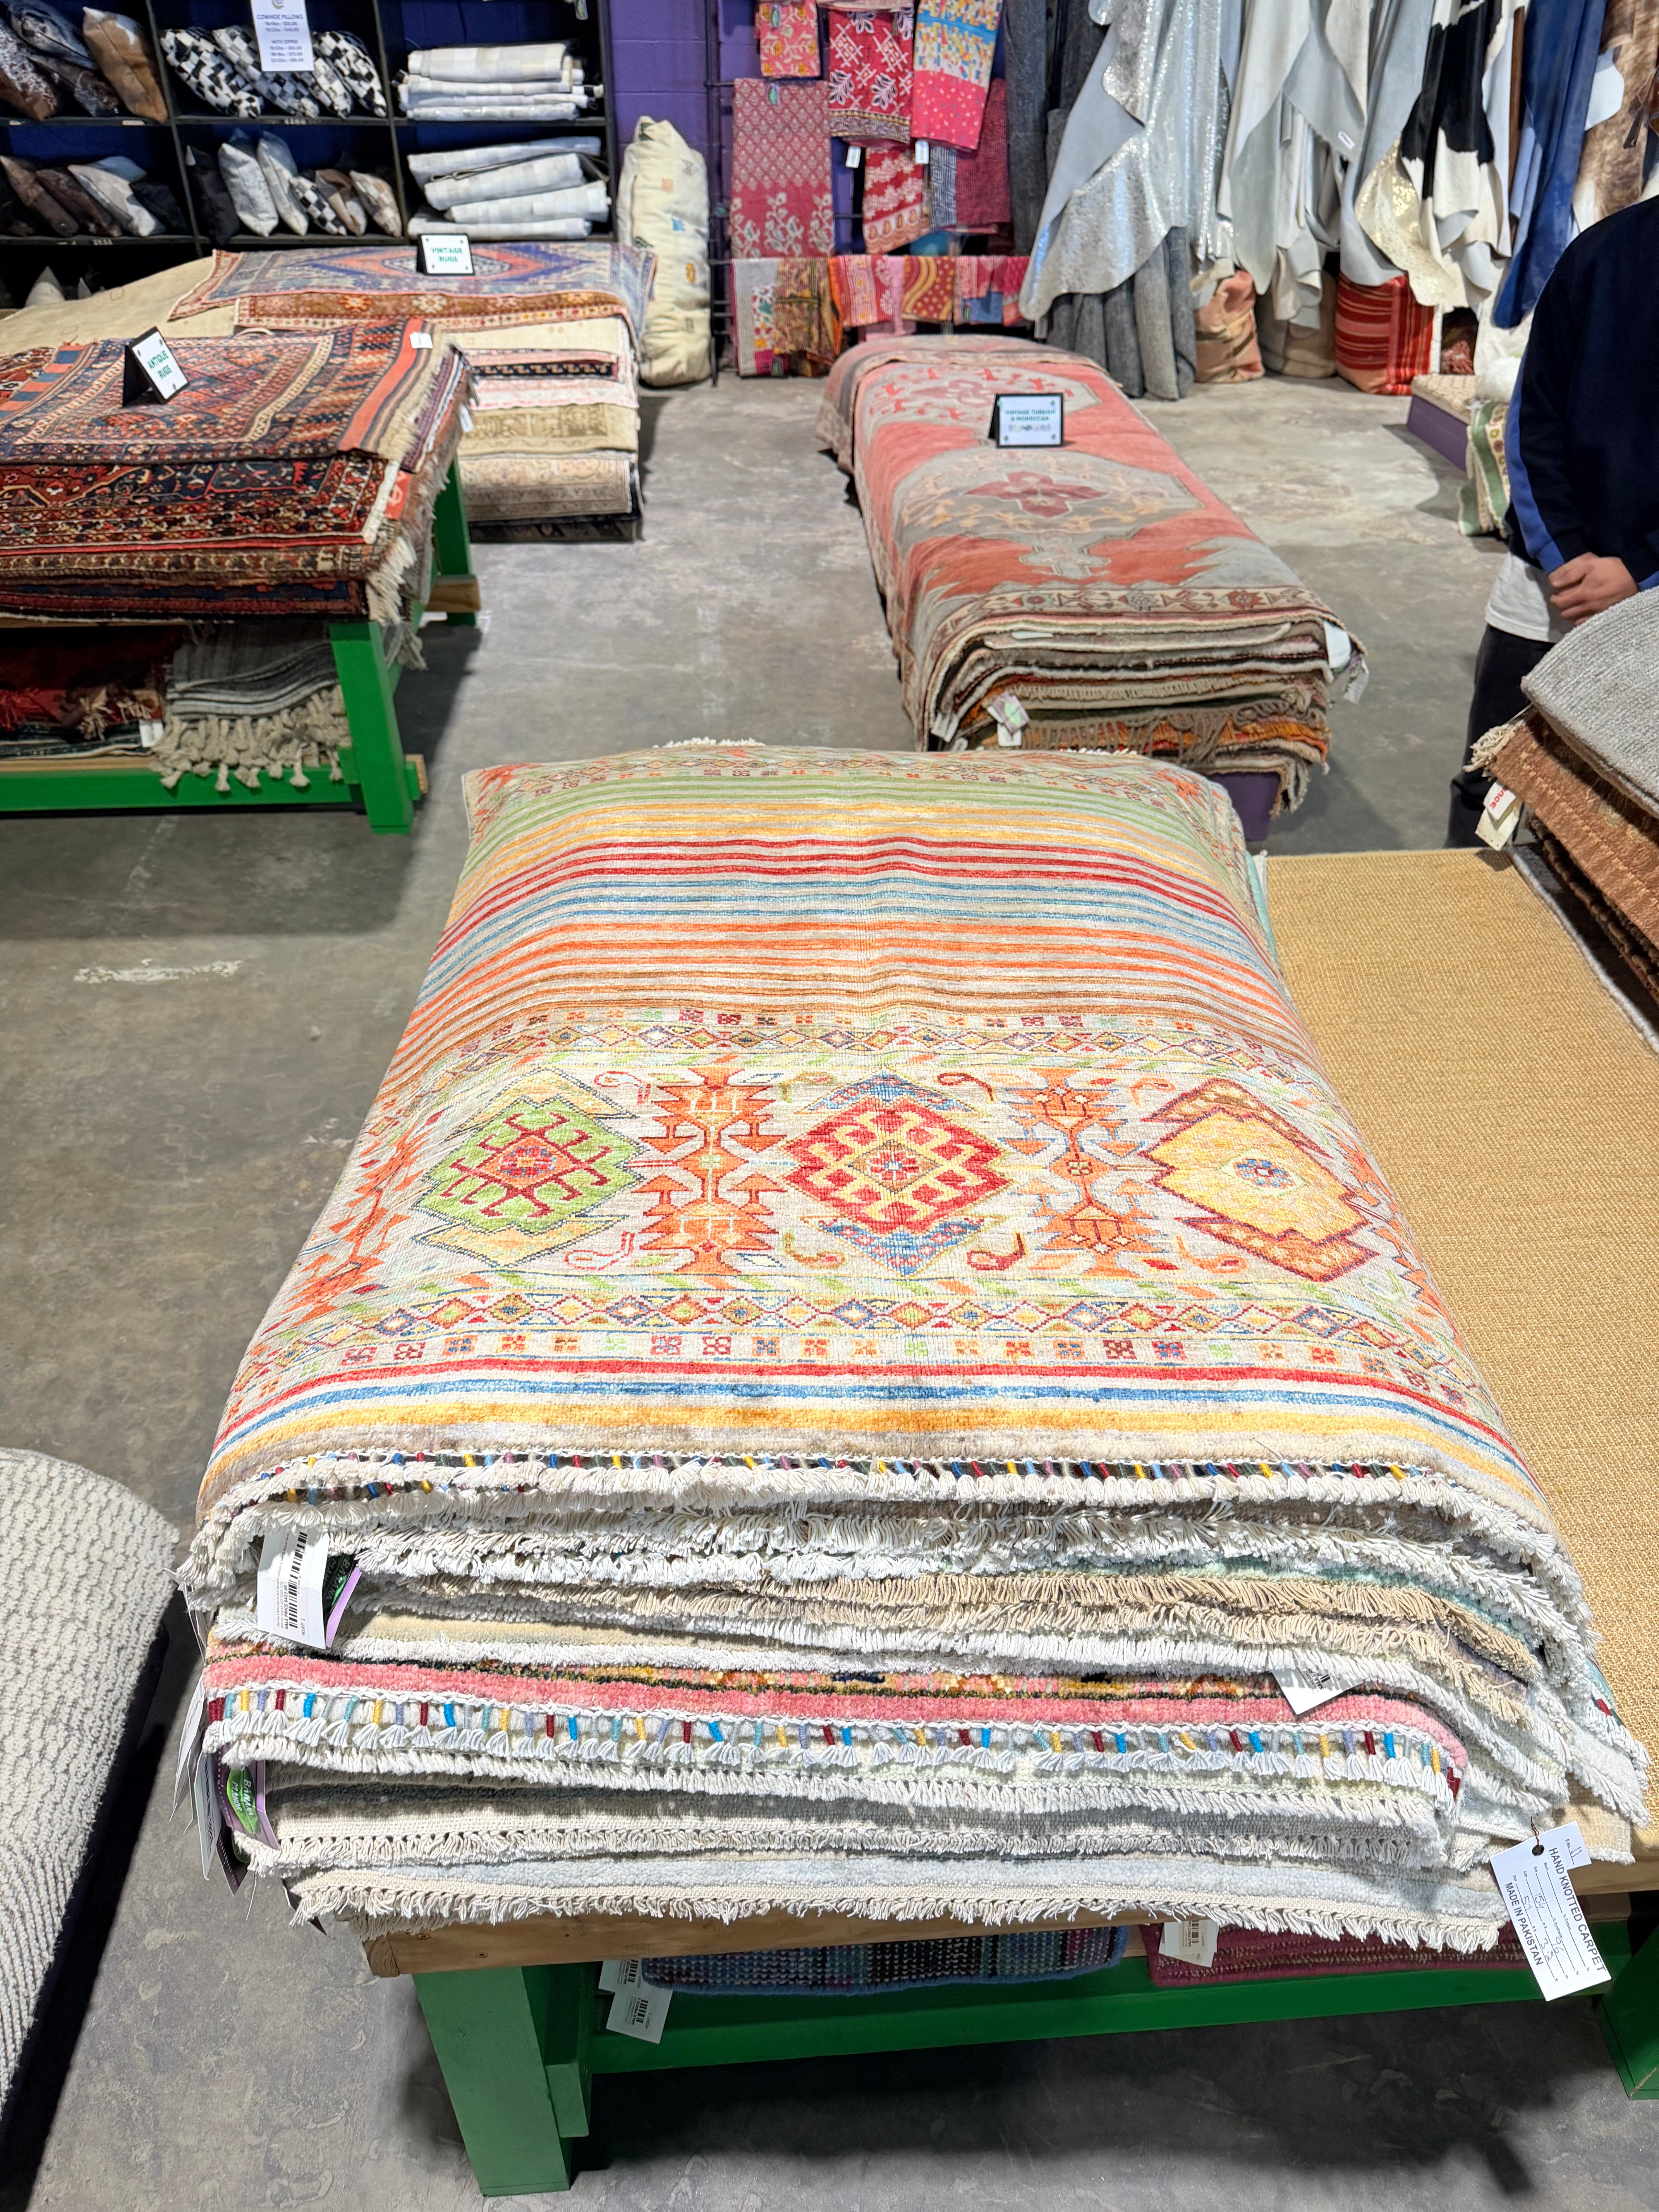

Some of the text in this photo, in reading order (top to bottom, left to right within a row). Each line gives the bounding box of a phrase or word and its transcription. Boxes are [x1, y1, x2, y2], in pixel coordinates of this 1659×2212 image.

[148, 350, 169, 369] ANTIQUE
[158, 365, 172, 379] RUGS
[324, 1558, 336, 1585] MAN
[326, 1558, 350, 1600] BANANA
[1314, 1677, 1324, 1690] SALE
[232, 1781, 242, 1812] MANOR
[1505, 1882, 1544, 1965] MADE IN PAKISTAN
[1549, 1848, 1606, 1971] HAND KNOTTED CARPET
